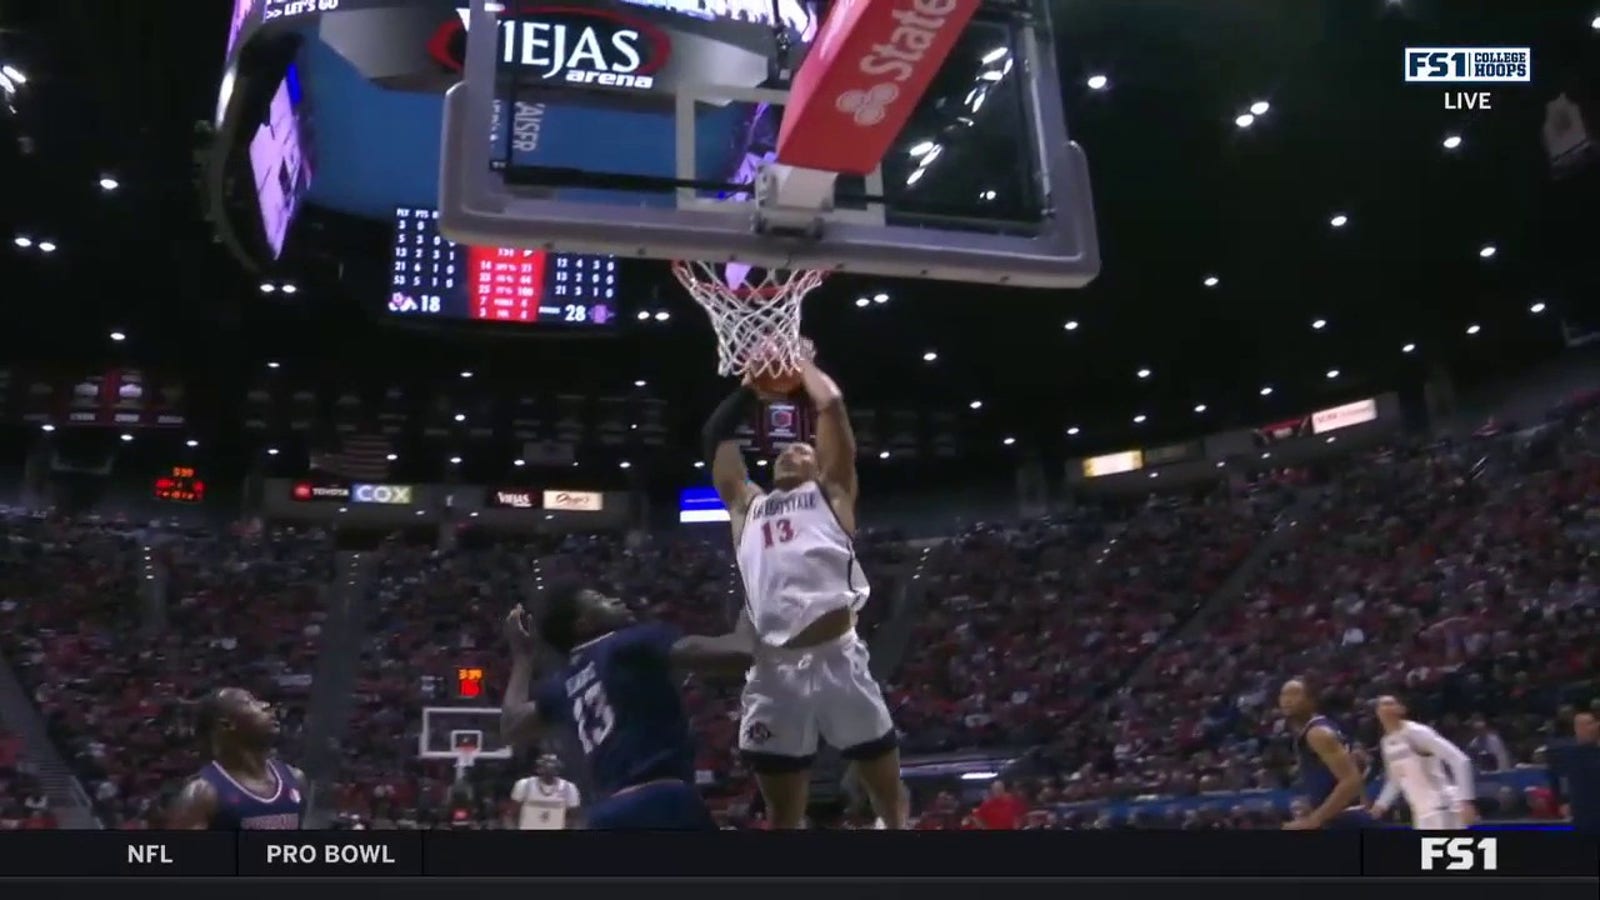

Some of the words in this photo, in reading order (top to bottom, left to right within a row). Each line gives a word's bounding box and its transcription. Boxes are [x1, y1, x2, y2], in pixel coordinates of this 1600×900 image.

[565, 69, 653, 88] arena
[421, 294, 441, 312] 18
[565, 304, 587, 322] 28
[356, 484, 410, 503] COX
[761, 518, 794, 548] 13
